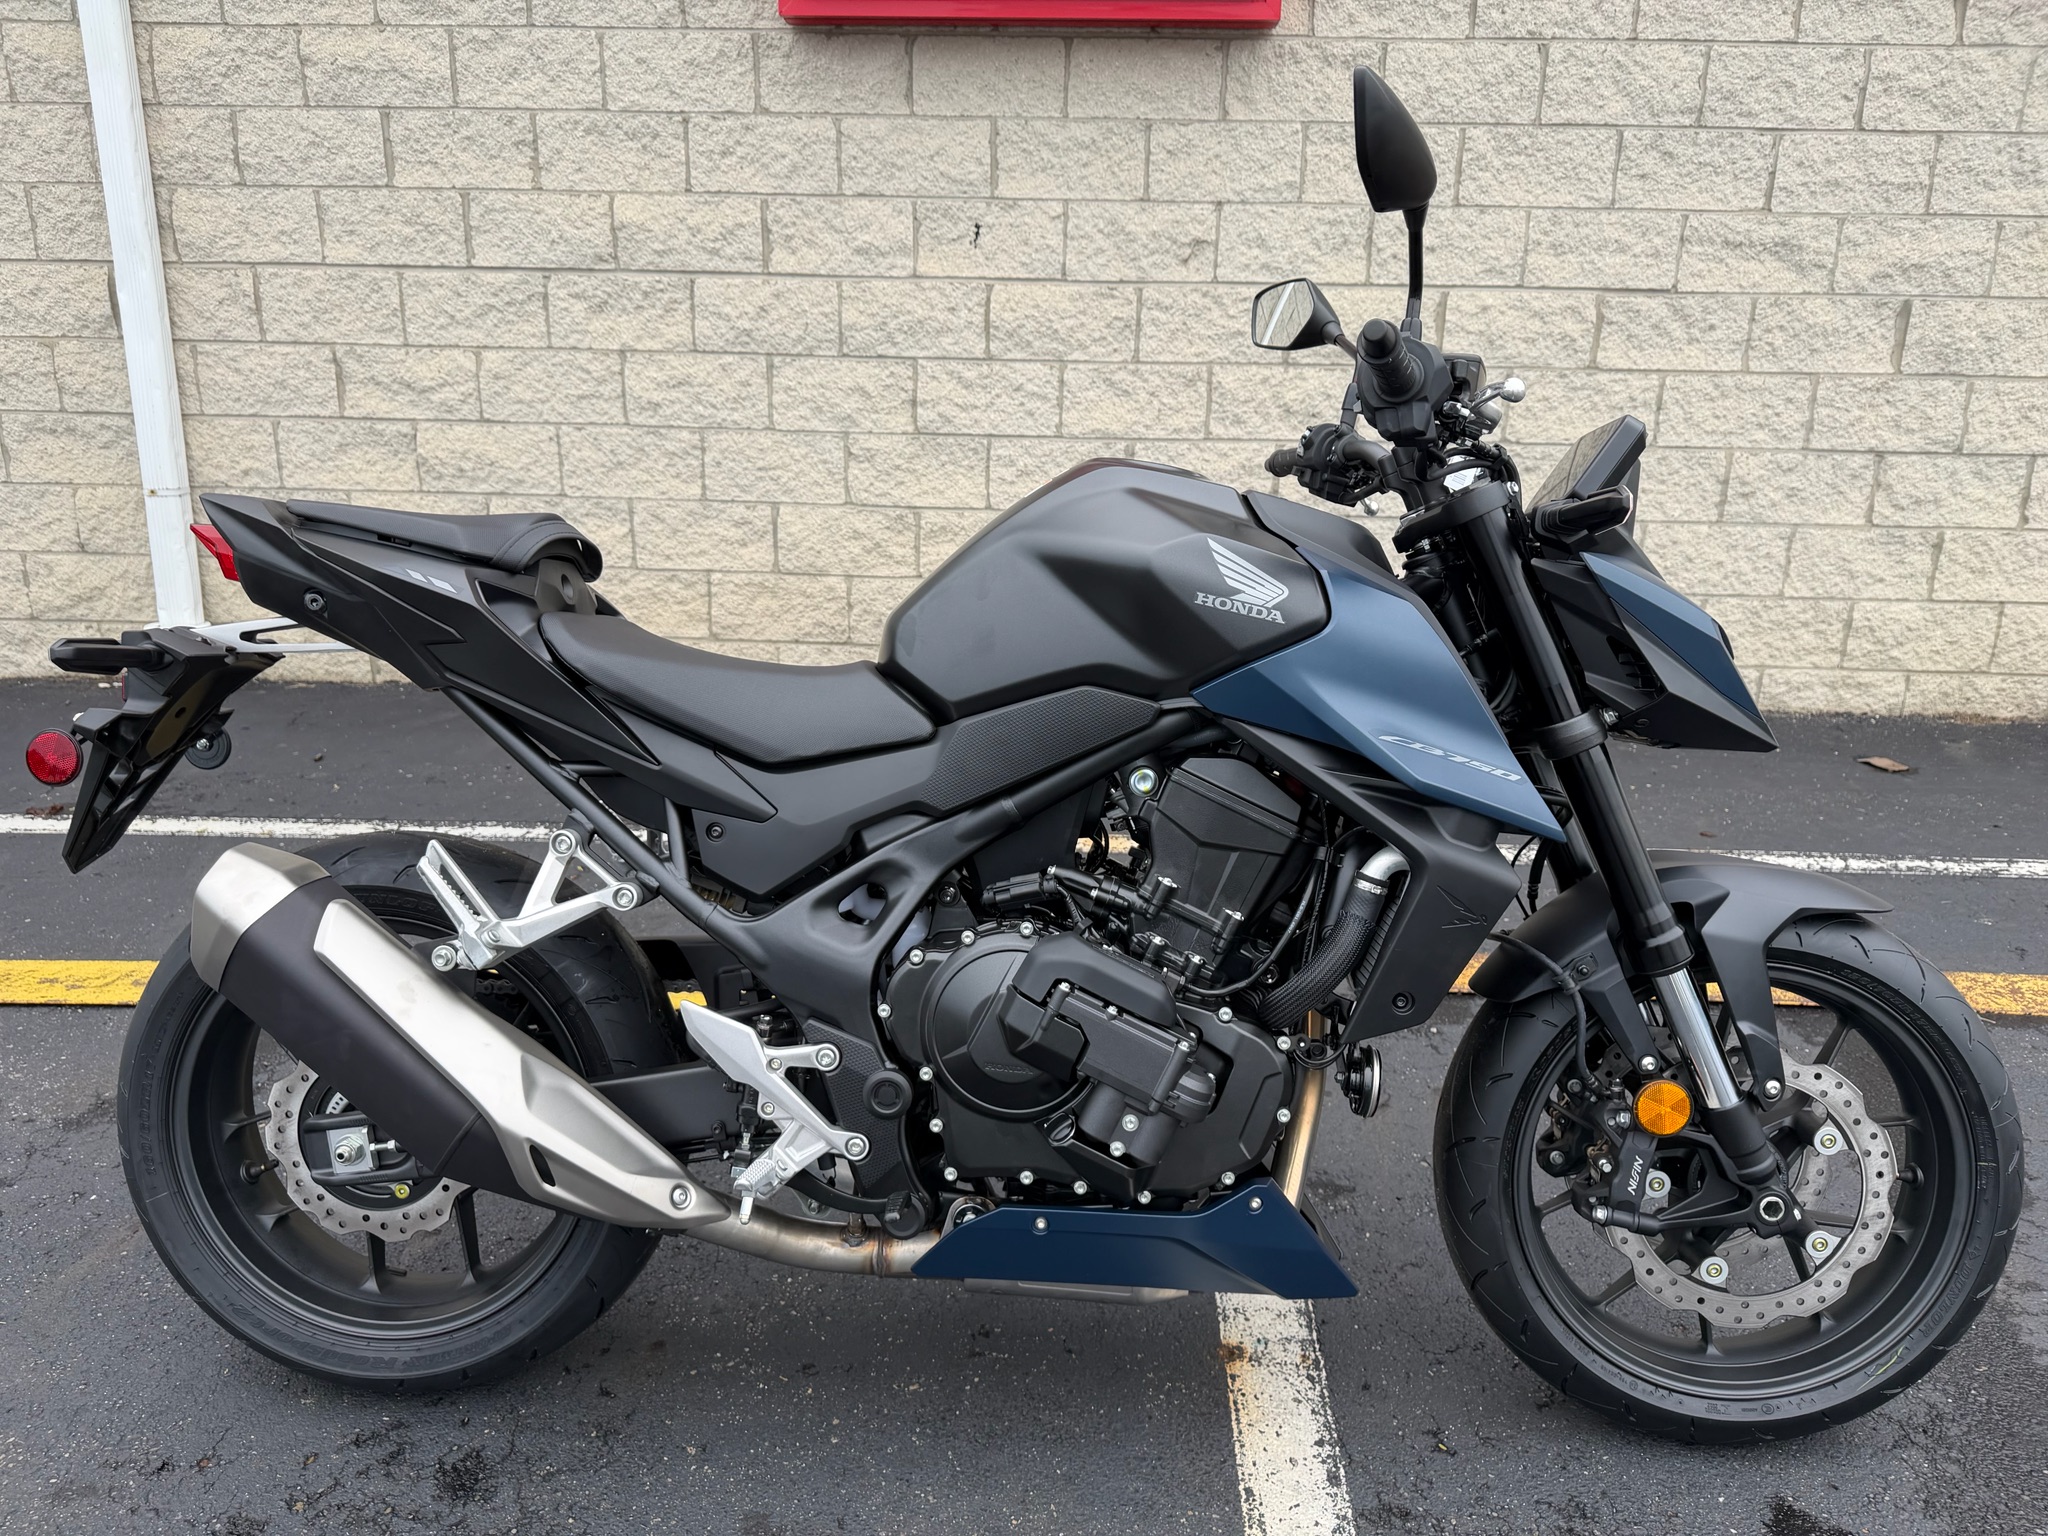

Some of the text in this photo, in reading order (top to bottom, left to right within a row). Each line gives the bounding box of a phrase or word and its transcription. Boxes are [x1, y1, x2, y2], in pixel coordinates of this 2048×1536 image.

[1195, 592, 1285, 624] HONDA
[1379, 735, 1522, 782] CB750
[1627, 1155, 1644, 1196] NISSIN
[1919, 1261, 1973, 1338] DUNLOP
